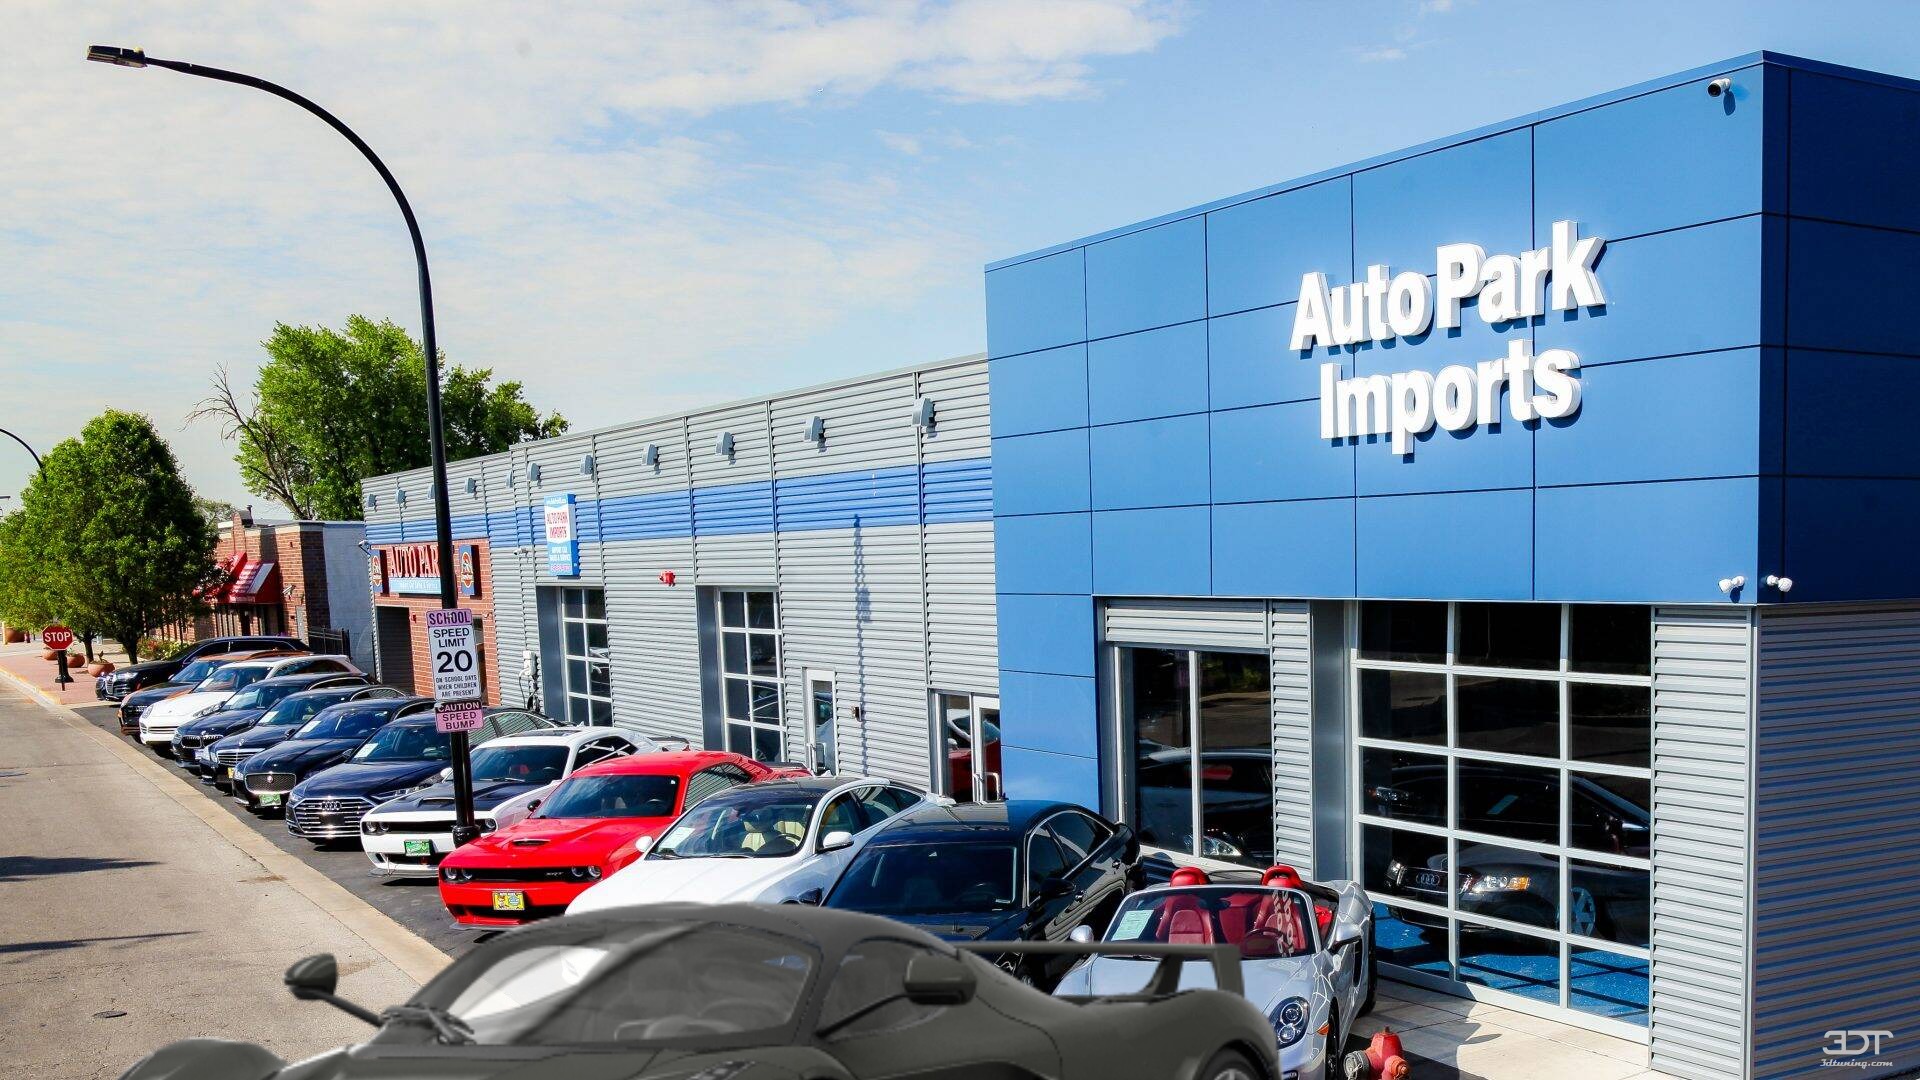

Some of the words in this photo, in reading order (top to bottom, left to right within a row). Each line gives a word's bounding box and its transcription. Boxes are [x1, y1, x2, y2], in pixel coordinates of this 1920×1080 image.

[1321, 339, 1583, 455] Imports
[390, 546, 418, 577] AUTO
[418, 545, 440, 577] PAR
[429, 612, 471, 625] SCHOOL
[44, 631, 70, 643] STOP
[434, 628, 469, 638] SPEED
[438, 638, 466, 648] LIMIT
[436, 650, 473, 673] 20
[454, 682, 477, 690] CHILDREN
[437, 702, 479, 712] CAUTION
[442, 711, 477, 721] SPEED
[445, 720, 475, 730] BUMP
